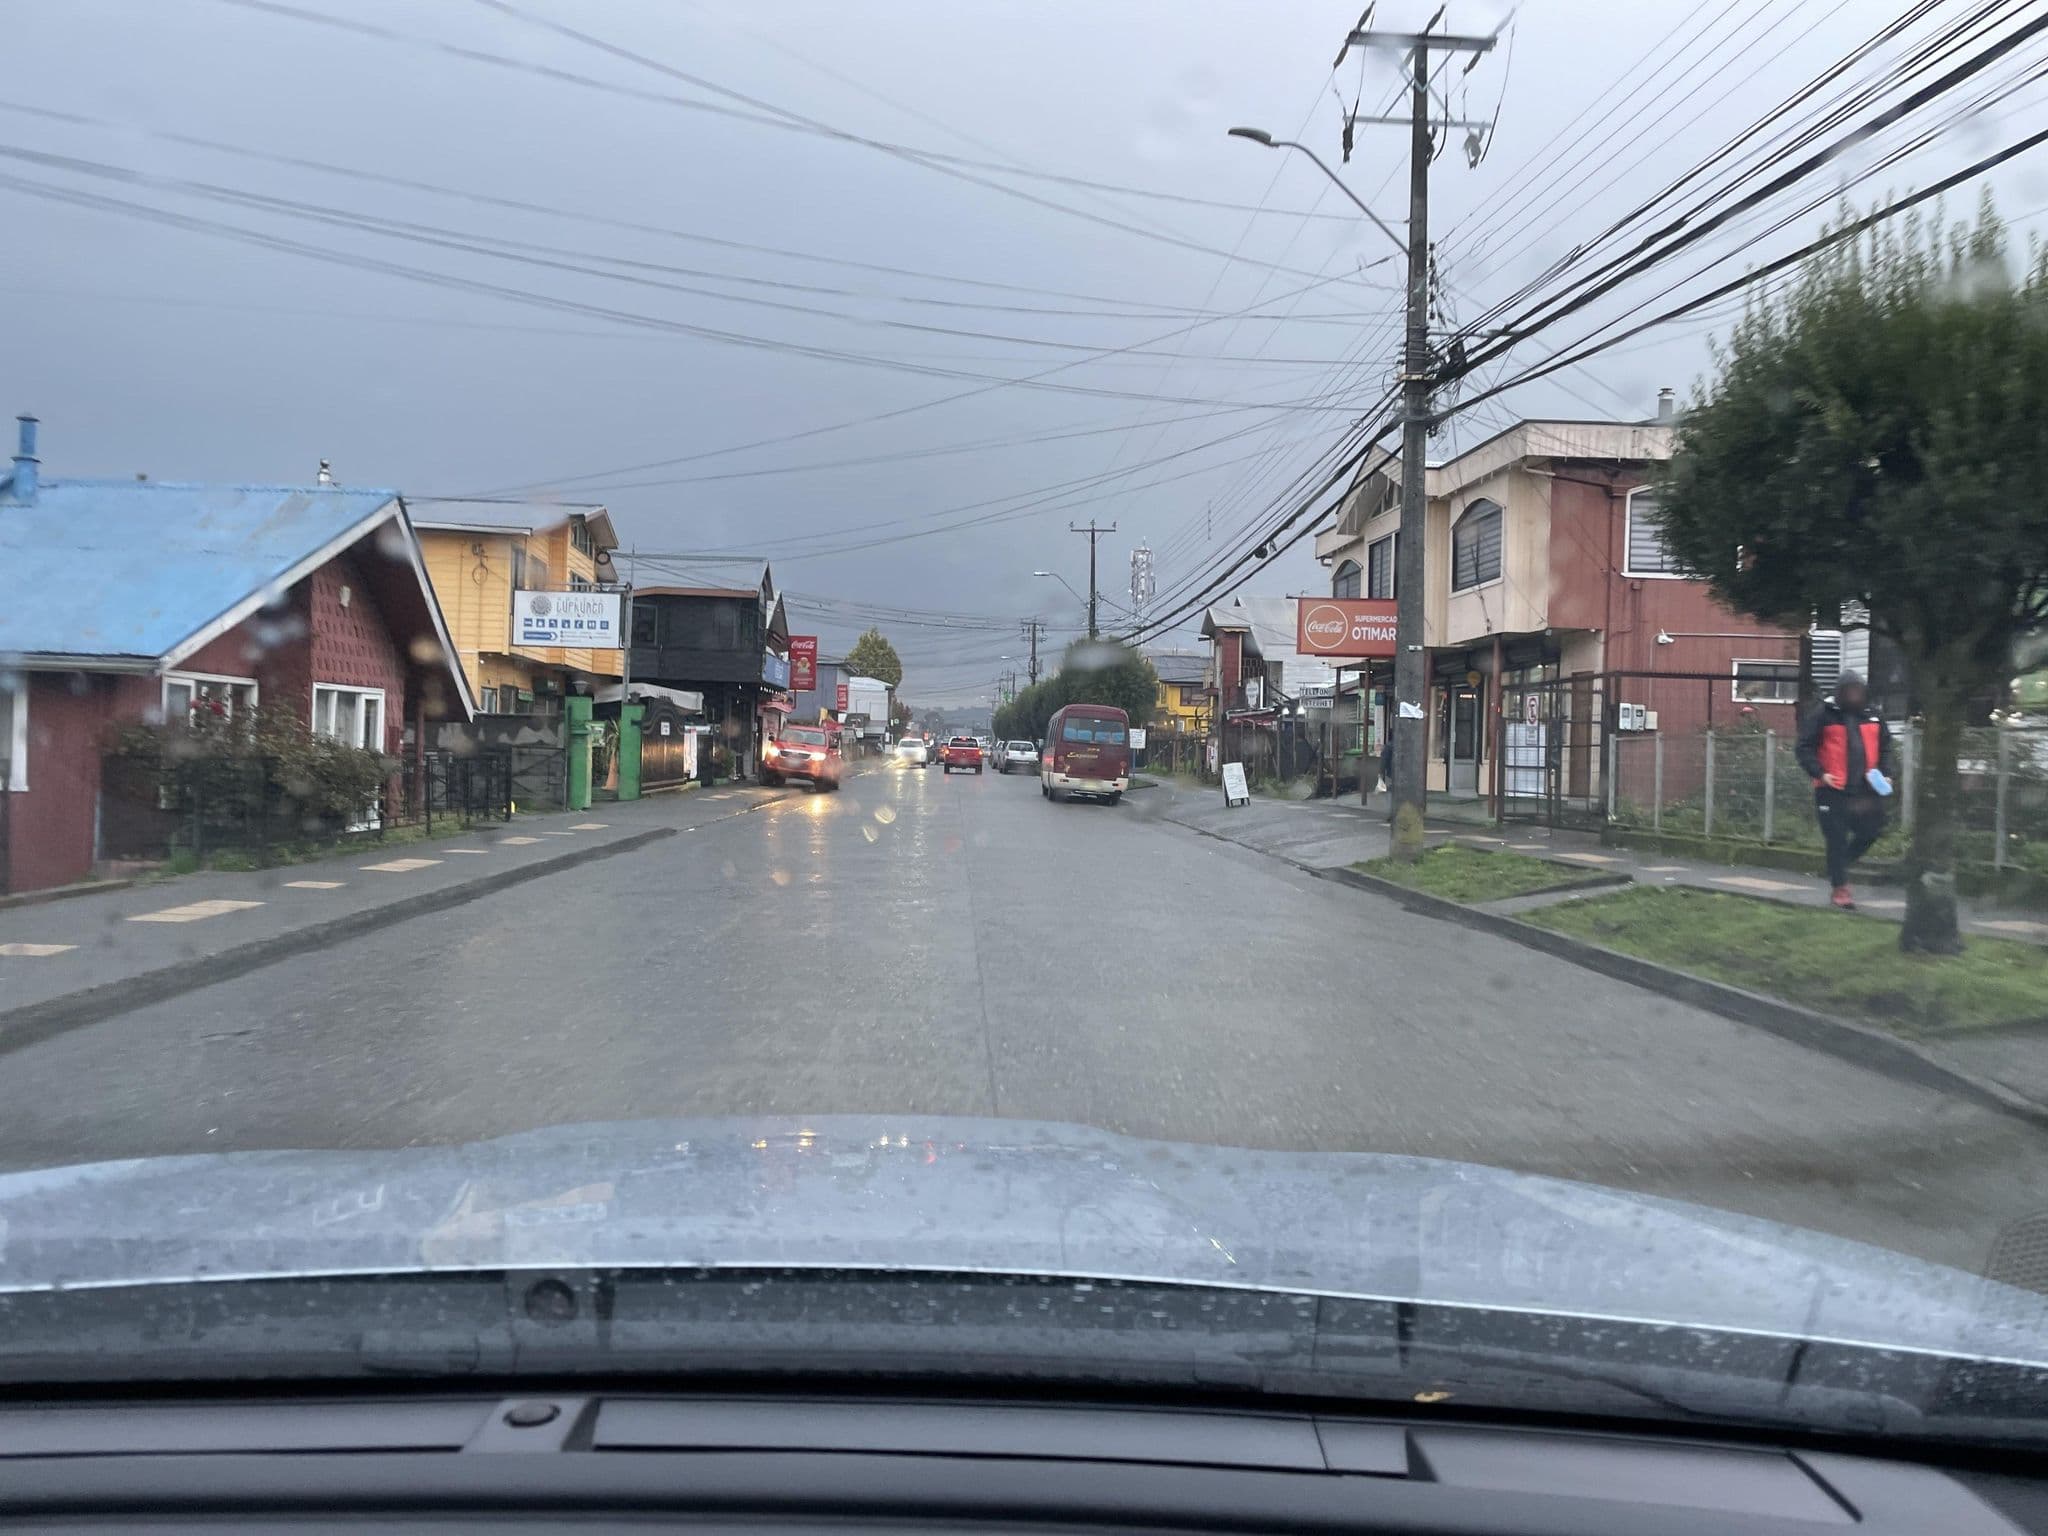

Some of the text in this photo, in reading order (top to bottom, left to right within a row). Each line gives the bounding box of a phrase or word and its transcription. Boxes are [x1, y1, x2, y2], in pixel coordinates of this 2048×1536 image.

[1355, 615, 1398, 623] SUPERMERCAD
[1308, 620, 1345, 633] Coca-Cola
[1352, 626, 1396, 641] OTIMAR
[791, 640, 816, 650] Coca-Cola
